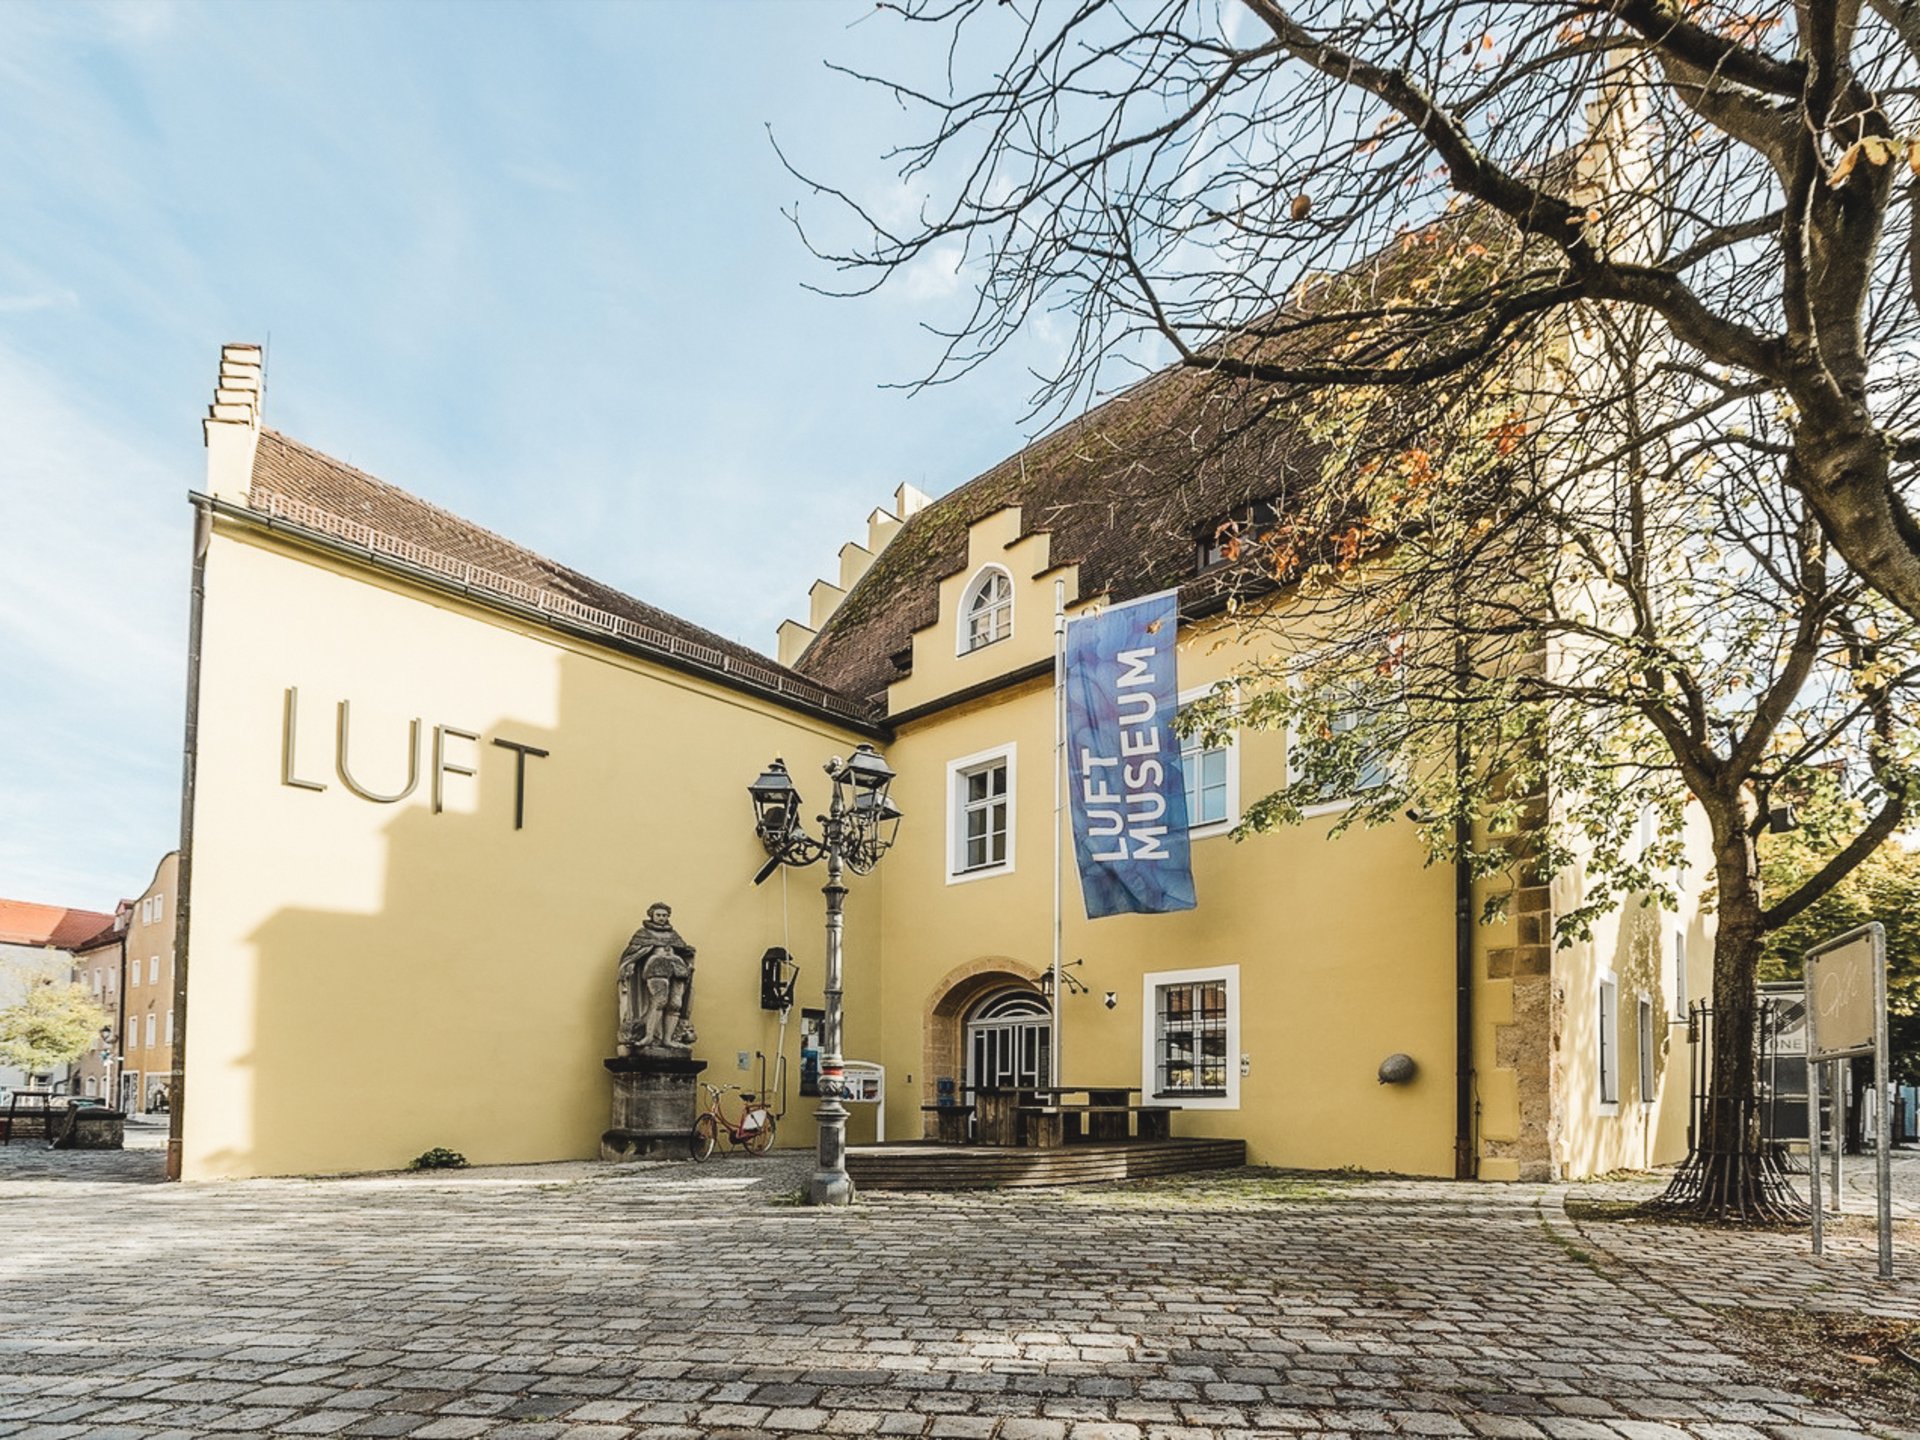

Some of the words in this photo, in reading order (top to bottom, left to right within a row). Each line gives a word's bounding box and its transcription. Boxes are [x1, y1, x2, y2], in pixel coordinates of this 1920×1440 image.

[283, 686, 549, 830] LUFT
[1082, 748, 1129, 861] LUFT
[1117, 646, 1170, 860] MUSEUM
